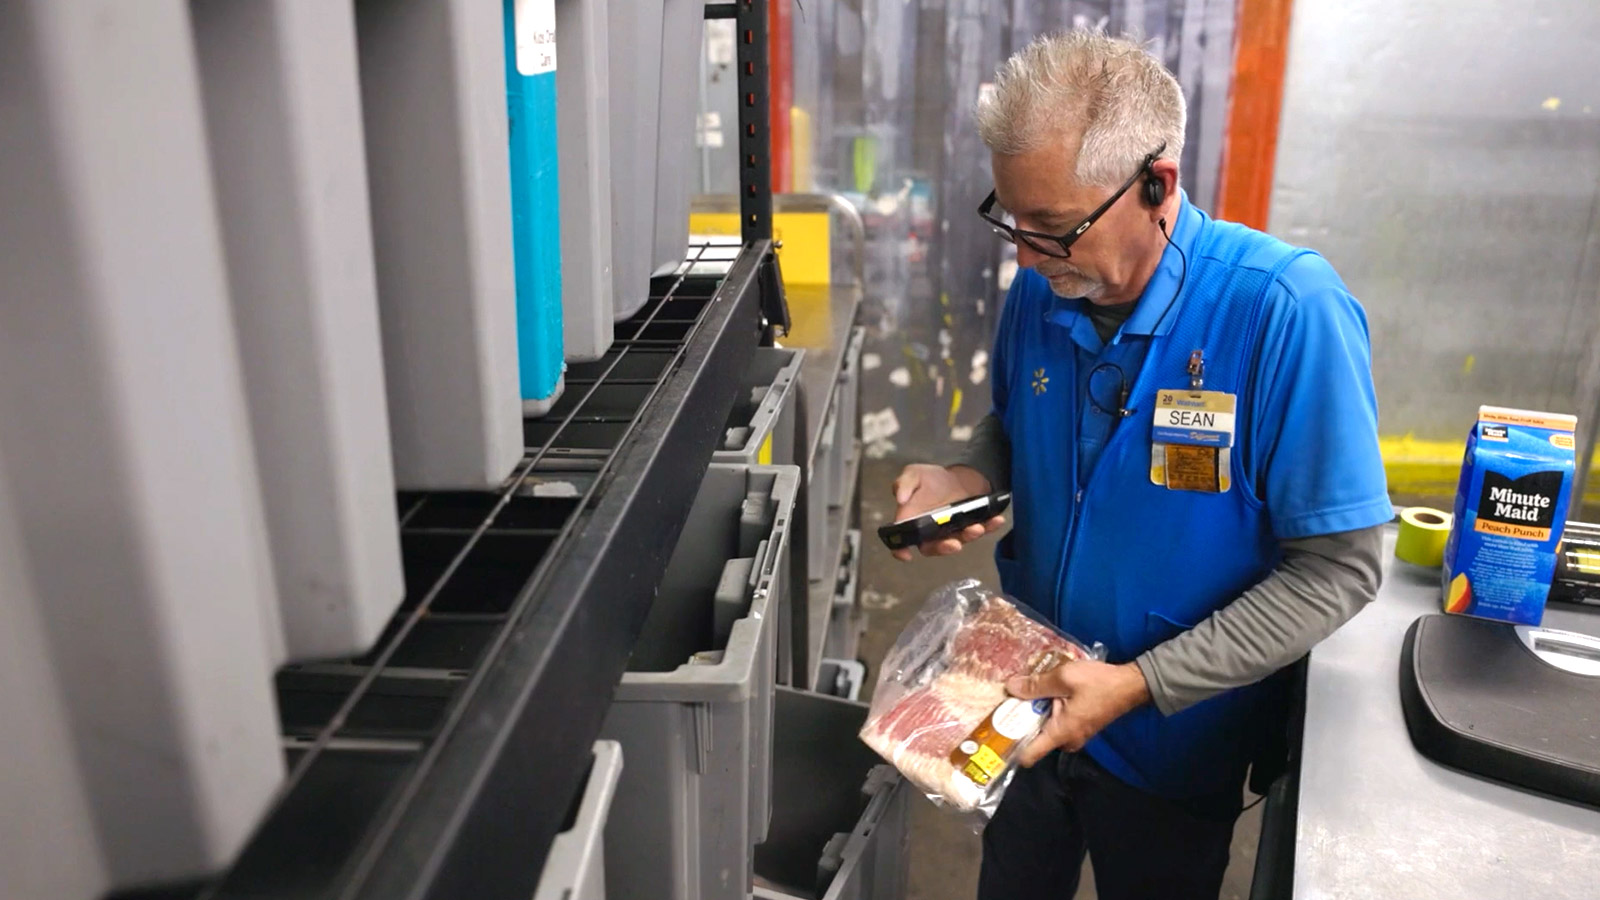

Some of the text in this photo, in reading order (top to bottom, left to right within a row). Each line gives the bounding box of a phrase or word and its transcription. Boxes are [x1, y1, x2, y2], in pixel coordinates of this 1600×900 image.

[1162, 394, 1173, 402] 20
[1169, 410, 1215, 428] SEAN
[1489, 486, 1551, 508] Minute
[1494, 502, 1539, 522] Maid
[1481, 521, 1544, 538] Peach Punch
